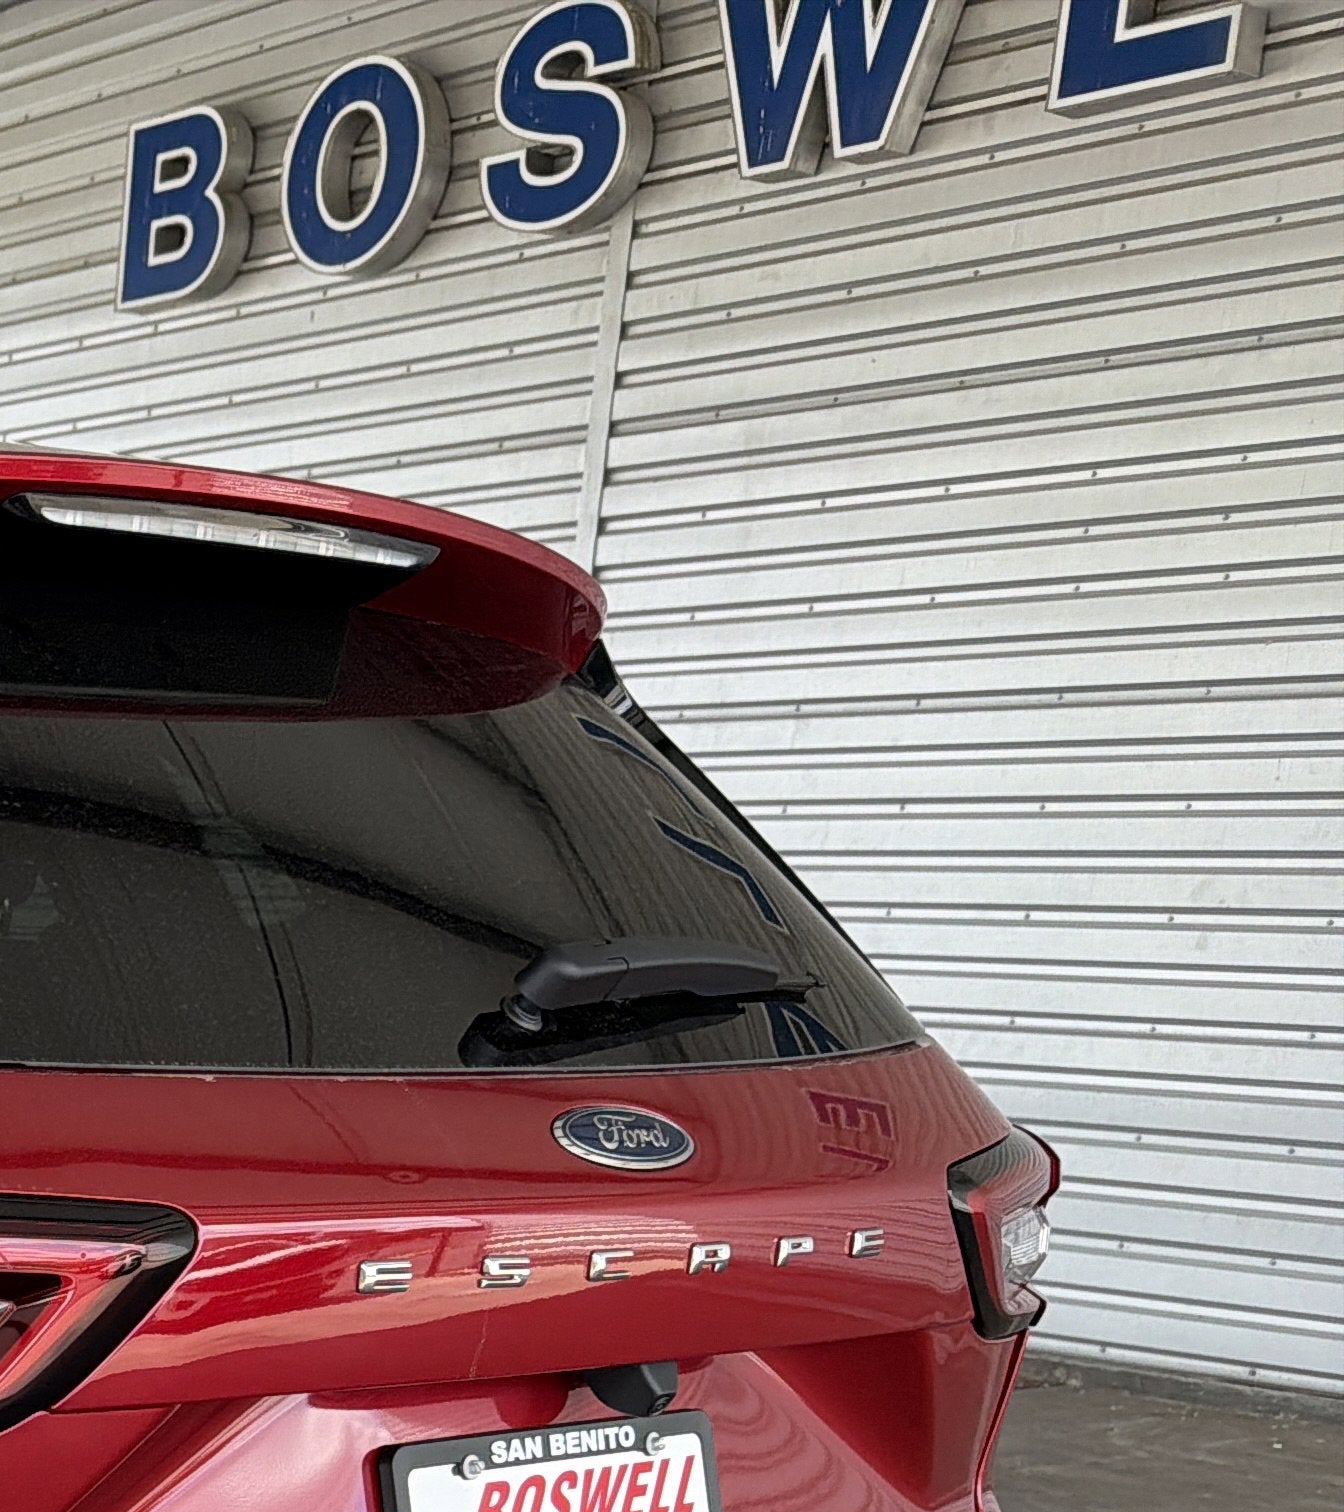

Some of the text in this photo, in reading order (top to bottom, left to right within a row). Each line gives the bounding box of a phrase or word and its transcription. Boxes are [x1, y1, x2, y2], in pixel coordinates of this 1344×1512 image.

[593, 1113, 670, 1151] Ford
[357, 1227, 884, 1294] ESCAPE
[491, 1425, 636, 1465] SAN BENITO
